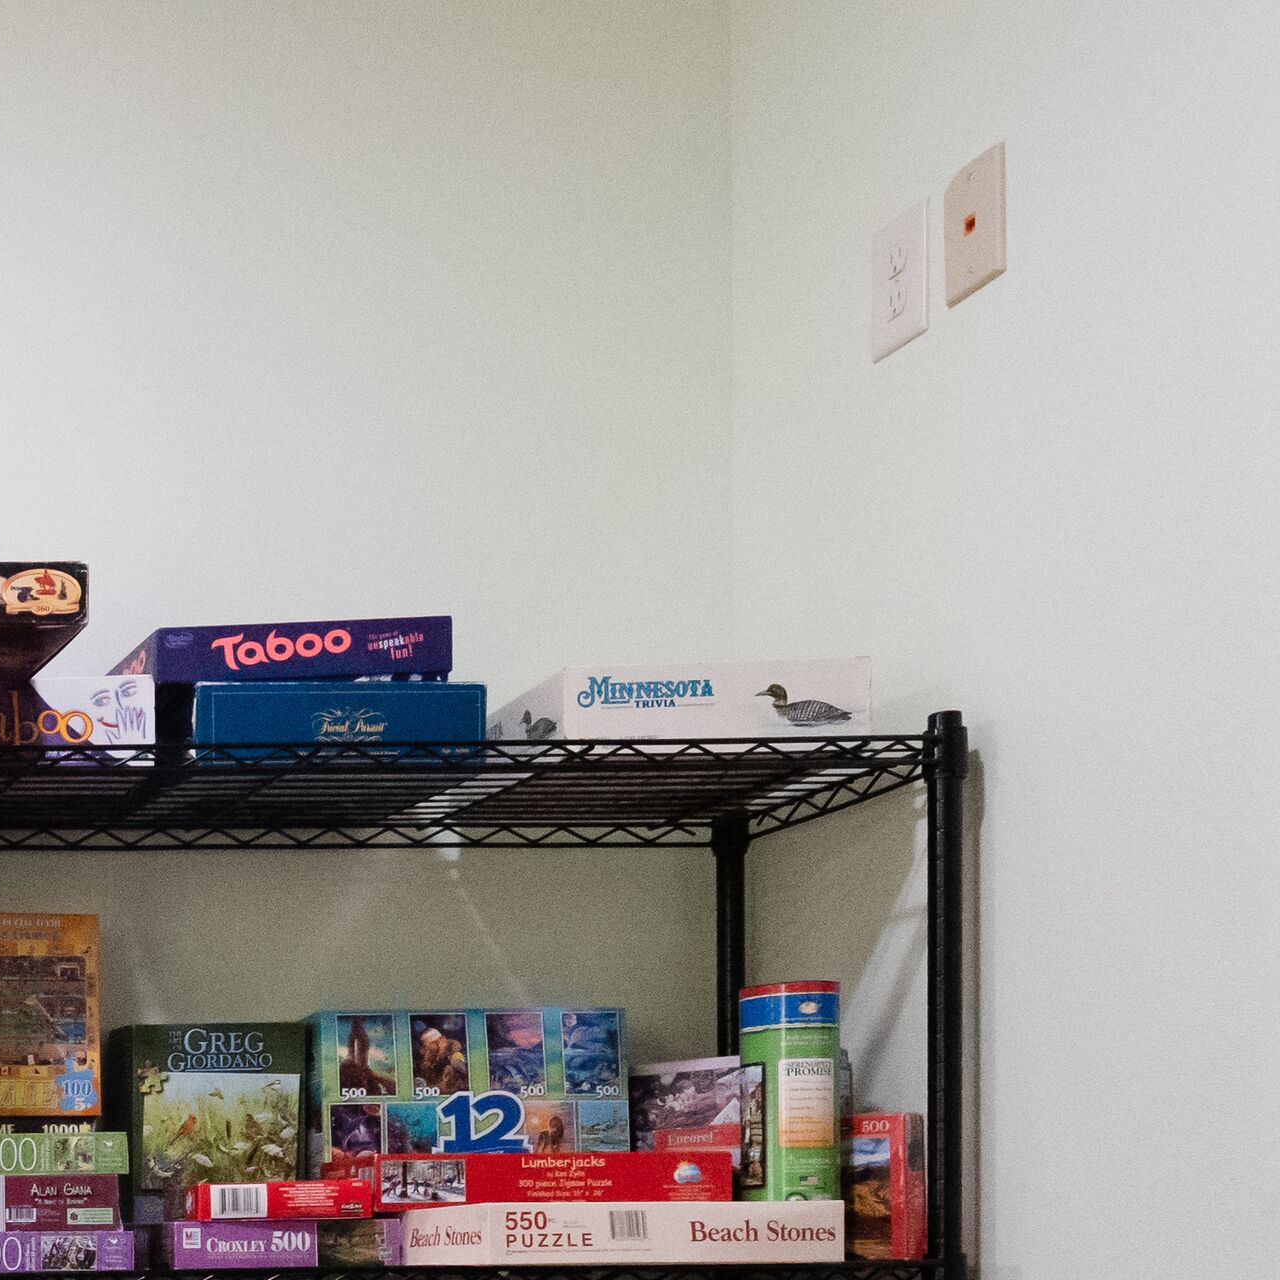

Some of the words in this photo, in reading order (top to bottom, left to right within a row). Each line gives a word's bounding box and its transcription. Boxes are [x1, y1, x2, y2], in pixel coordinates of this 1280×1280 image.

[210, 628, 353, 672] Taboo
[577, 675, 715, 709] MINNESOTA
[633, 699, 677, 709] TRIVIA
[183, 1028, 265, 1054] GREG
[166, 1051, 274, 1072] GIORDANO
[341, 1087, 368, 1100] 500
[414, 1087, 440, 1099] 500
[595, 1084, 620, 1097] 500
[861, 1119, 890, 1133] 500
[521, 1155, 606, 1169] Lumberjacks
[504, 1211, 548, 1231] 550
[690, 1220, 759, 1242] Beach
[766, 1220, 836, 1242] Stones
[206, 1237, 267, 1255] CROXLEY
[270, 1231, 311, 1253] 500
[409, 1225, 440, 1249] Beach
[442, 1224, 482, 1247] Stones
[505, 1233, 595, 1248] PUZZLE
